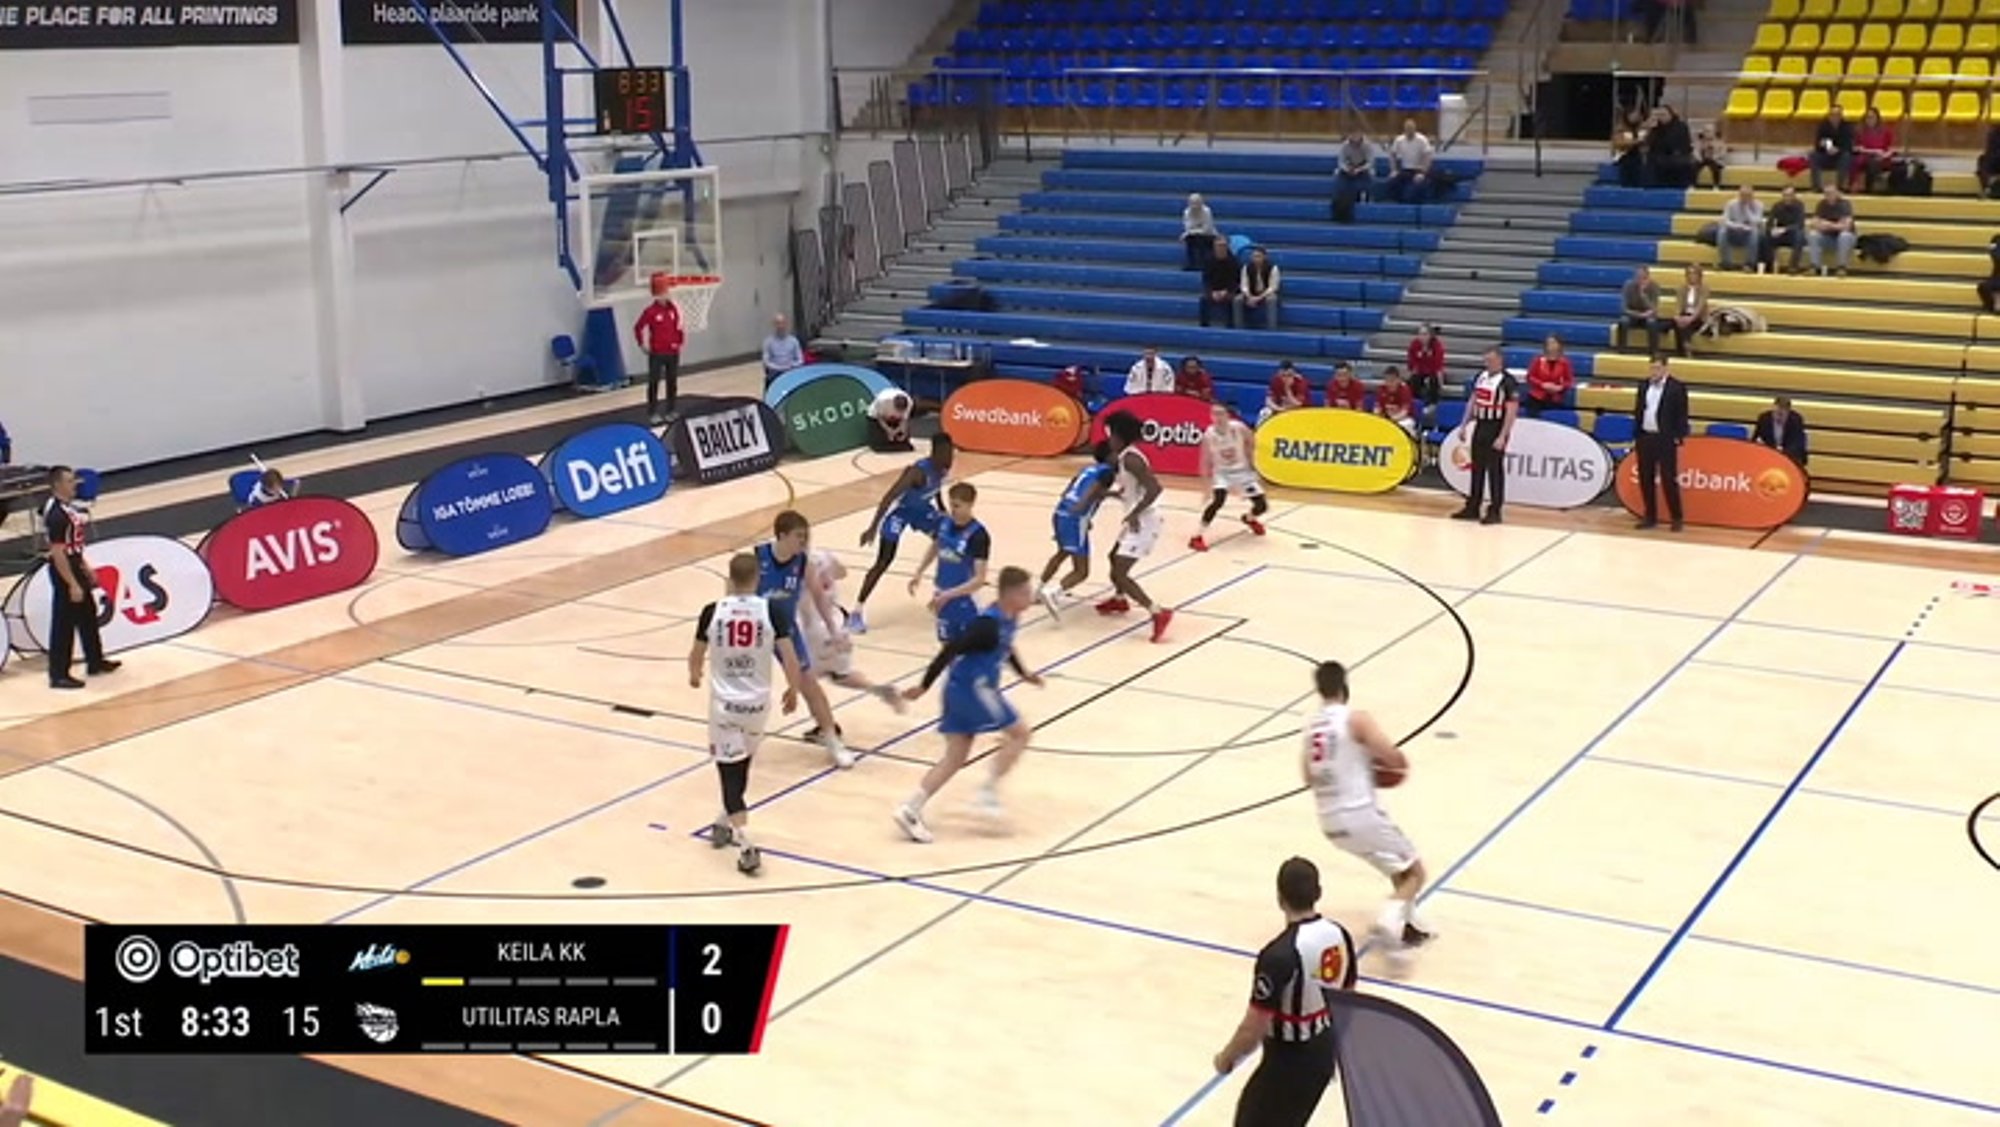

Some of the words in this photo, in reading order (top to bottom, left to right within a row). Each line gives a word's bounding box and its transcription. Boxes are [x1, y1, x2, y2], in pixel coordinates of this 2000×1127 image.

[26, 7, 90, 25] PLACE
[97, 7, 135, 25] FOR
[140, 7, 174, 25] ALL
[180, 7, 278, 25] PRINTINGS
[429, 3, 498, 24] plaanide
[502, 4, 539, 28] pank
[619, 71, 660, 94] 833
[626, 96, 657, 131] 15
[952, 403, 1042, 426] Swedbank
[696, 414, 759, 458] BALLZY
[1141, 420, 1202, 446] Optib
[1274, 438, 1394, 467] RAMIRENT
[567, 441, 656, 502] Delfi
[1505, 453, 1595, 482] TILITAS
[246, 521, 340, 581] AVIS
[726, 620, 753, 647] 19
